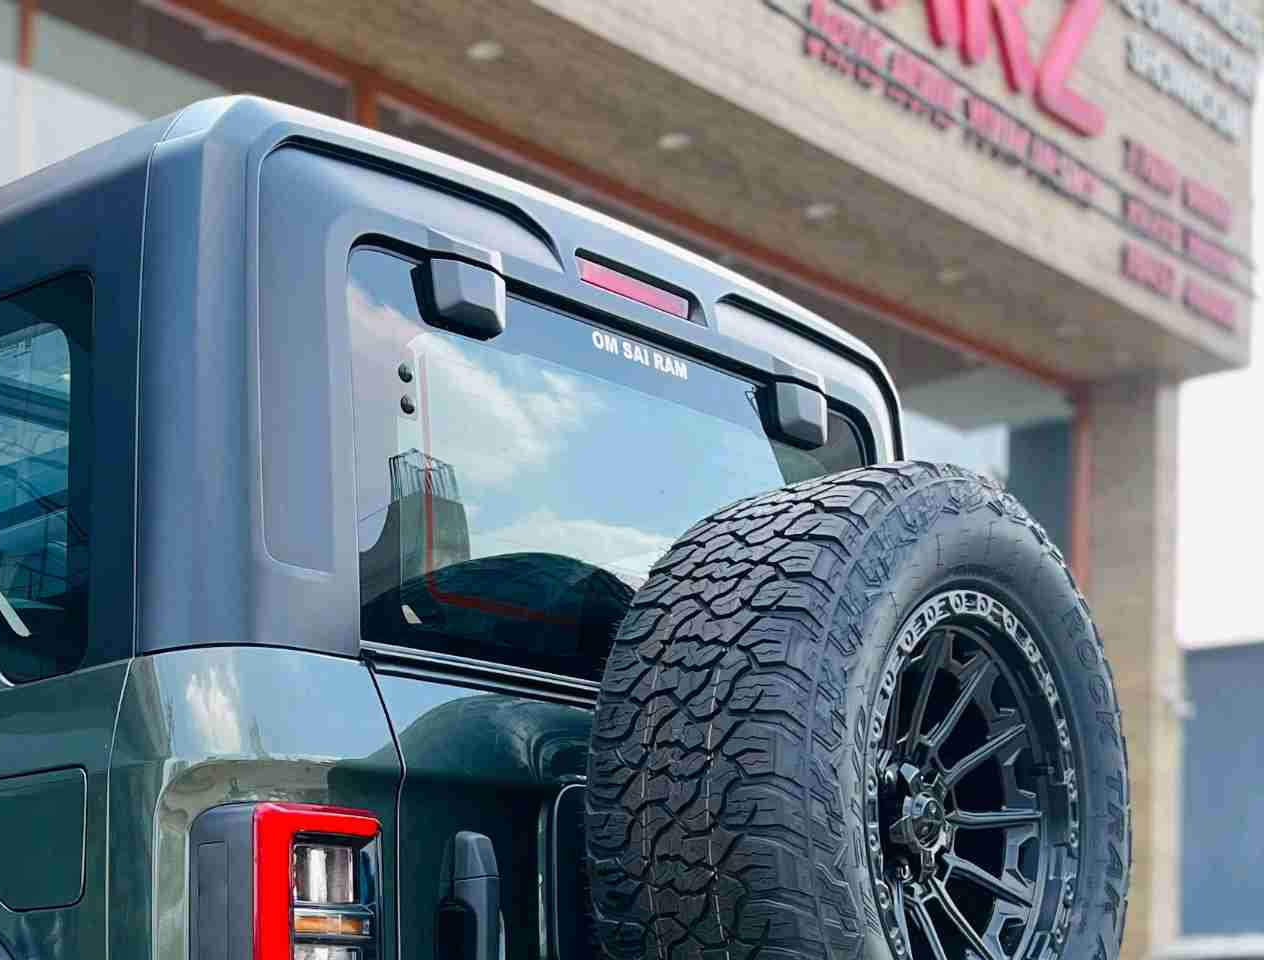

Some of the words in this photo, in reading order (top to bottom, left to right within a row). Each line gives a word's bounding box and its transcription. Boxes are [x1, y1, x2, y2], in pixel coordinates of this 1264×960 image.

[592, 330, 619, 356] OM
[622, 340, 650, 367] SAI
[653, 351, 689, 381] RAM
[1057, 606, 1122, 750] ROCK
[1103, 769, 1124, 932] TRAK
